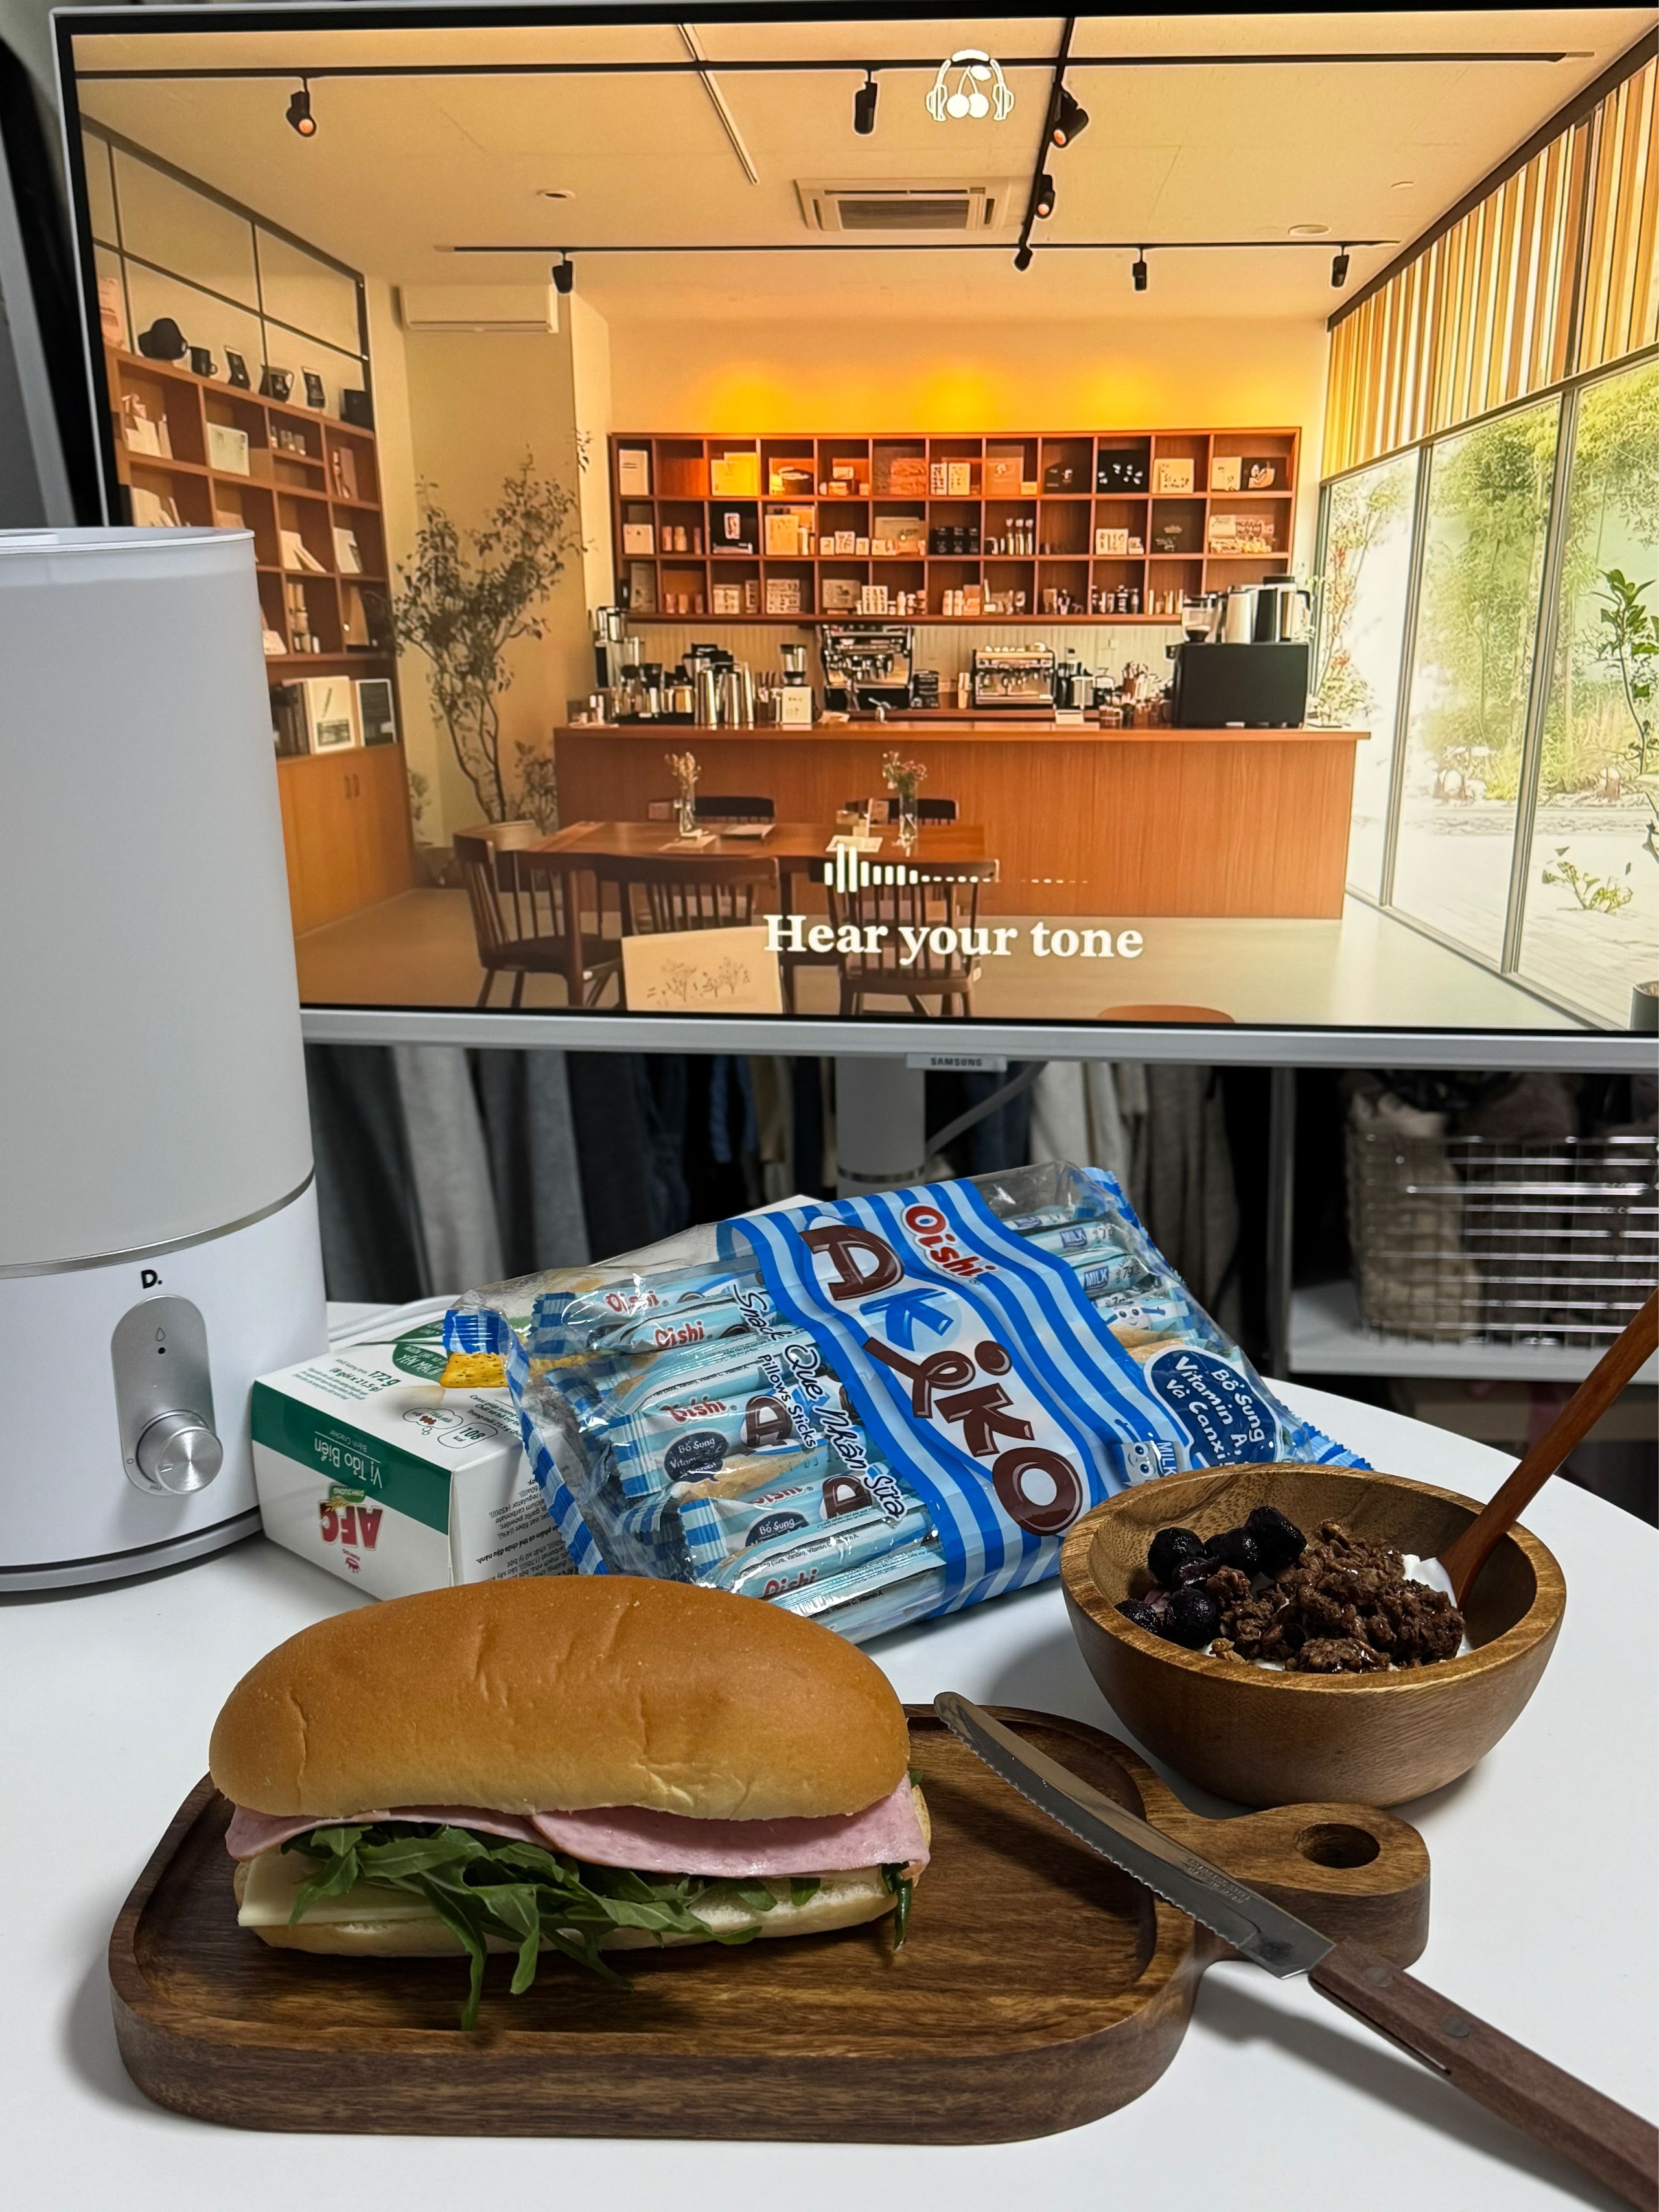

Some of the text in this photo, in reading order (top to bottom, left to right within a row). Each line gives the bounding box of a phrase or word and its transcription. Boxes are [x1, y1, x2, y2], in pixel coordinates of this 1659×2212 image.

[762, 914, 1144, 966] Hear your tone
[931, 1057, 982, 1066] SAMSUNG
[905, 1205, 997, 1277] Oishi
[1061, 1228, 1087, 1244] MILK
[141, 1270, 163, 1288] D.
[1085, 1267, 1108, 1285] MILK
[655, 1321, 705, 1349] Oishi
[368, 1371, 392, 1382] 172
[733, 1284, 789, 1341] Snack
[785, 1344, 824, 1402] Que
[813, 1406, 867, 1471] Nhân
[864, 1475, 905, 1519] Sữa
[758, 1354, 817, 1449] Pillows Sticks
[1174, 1356, 1248, 1456] Vitamin A,
[1211, 1369, 1266, 1443] Bổ Sung
[459, 1427, 486, 1440] 108
[693, 1438, 716, 1450] Sung
[314, 1438, 340, 1469] Biển
[1156, 1441, 1178, 1476] MILK
[370, 1461, 383, 1489] Vị
[495, 1498, 545, 1524] alcium carbonate
[512, 1493, 539, 1509] regulator
[319, 1502, 384, 1550] AFC
[524, 1509, 540, 1520] garlic
[773, 1518, 795, 1531] Sung
[807, 1544, 828, 1554] Vitamin
